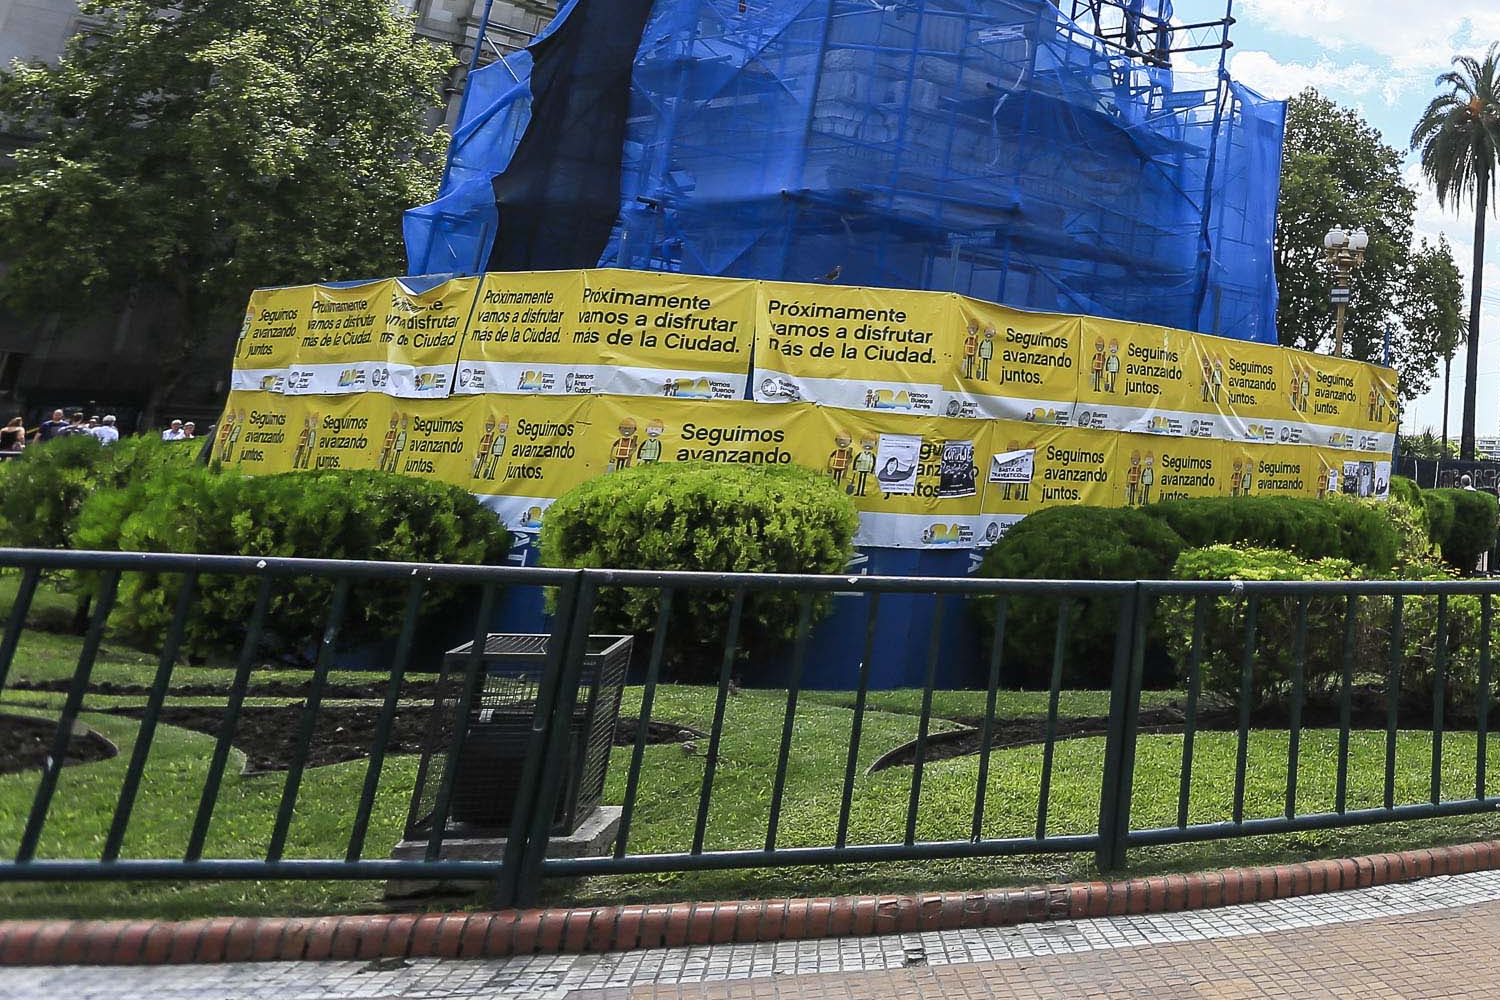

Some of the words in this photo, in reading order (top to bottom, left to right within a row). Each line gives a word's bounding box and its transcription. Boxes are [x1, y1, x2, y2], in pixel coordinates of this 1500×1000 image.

[483, 289, 554, 304] Próximamente
[582, 288, 711, 311] Próximamente
[477, 310, 510, 323] vamos
[521, 308, 564, 324] disfrutar
[768, 299, 906, 323] Próximamente
[407, 315, 460, 329] disfrutar
[578, 310, 629, 325] vamos
[636, 312, 647, 326] a
[654, 312, 738, 332] disfrutar
[320, 333, 332, 346] de
[471, 327, 492, 342] más
[495, 327, 508, 342] de
[511, 327, 520, 342] la
[523, 327, 561, 343] Ciudad.
[573, 327, 600, 344] más
[607, 329, 632, 345] de
[640, 331, 657, 347] la
[664, 331, 740, 353] Ciudad.
[835, 326, 847, 339] a
[854, 323, 933, 344] disfrutar
[1006, 328, 1068, 349] Seguimos
[810, 342, 835, 358] de
[841, 343, 857, 359] la
[864, 344, 937, 364] Ciudad.
[1002, 348, 1072, 368] avanzando
[1000, 366, 1043, 385] juntos.
[1228, 358, 1273, 376] Seguimos
[1124, 379, 1162, 396] juntos.
[1228, 375, 1276, 391] avanzando
[1316, 371, 1354, 387] Seguimos
[1315, 388, 1357, 402] avanzando
[1313, 400, 1340, 415] juntos.
[413, 415, 464, 437] Seguimos
[517, 418, 574, 441] Seguimos
[681, 423, 784, 445] Seguimos
[409, 436, 464, 454] avanzando
[511, 440, 575, 459] avanzando
[676, 447, 792, 465] avanzando
[1046, 446, 1104, 465] Seguimos
[1162, 454, 1212, 473] Seguimos
[404, 457, 435, 475] juntos.
[503, 462, 544, 482] juntos.
[1044, 464, 1108, 483] avanzando
[1258, 460, 1300, 476] Seguimos
[1160, 472, 1215, 487] avanzando
[1257, 475, 1303, 490] avanzando
[1040, 484, 1081, 503] juntos.
